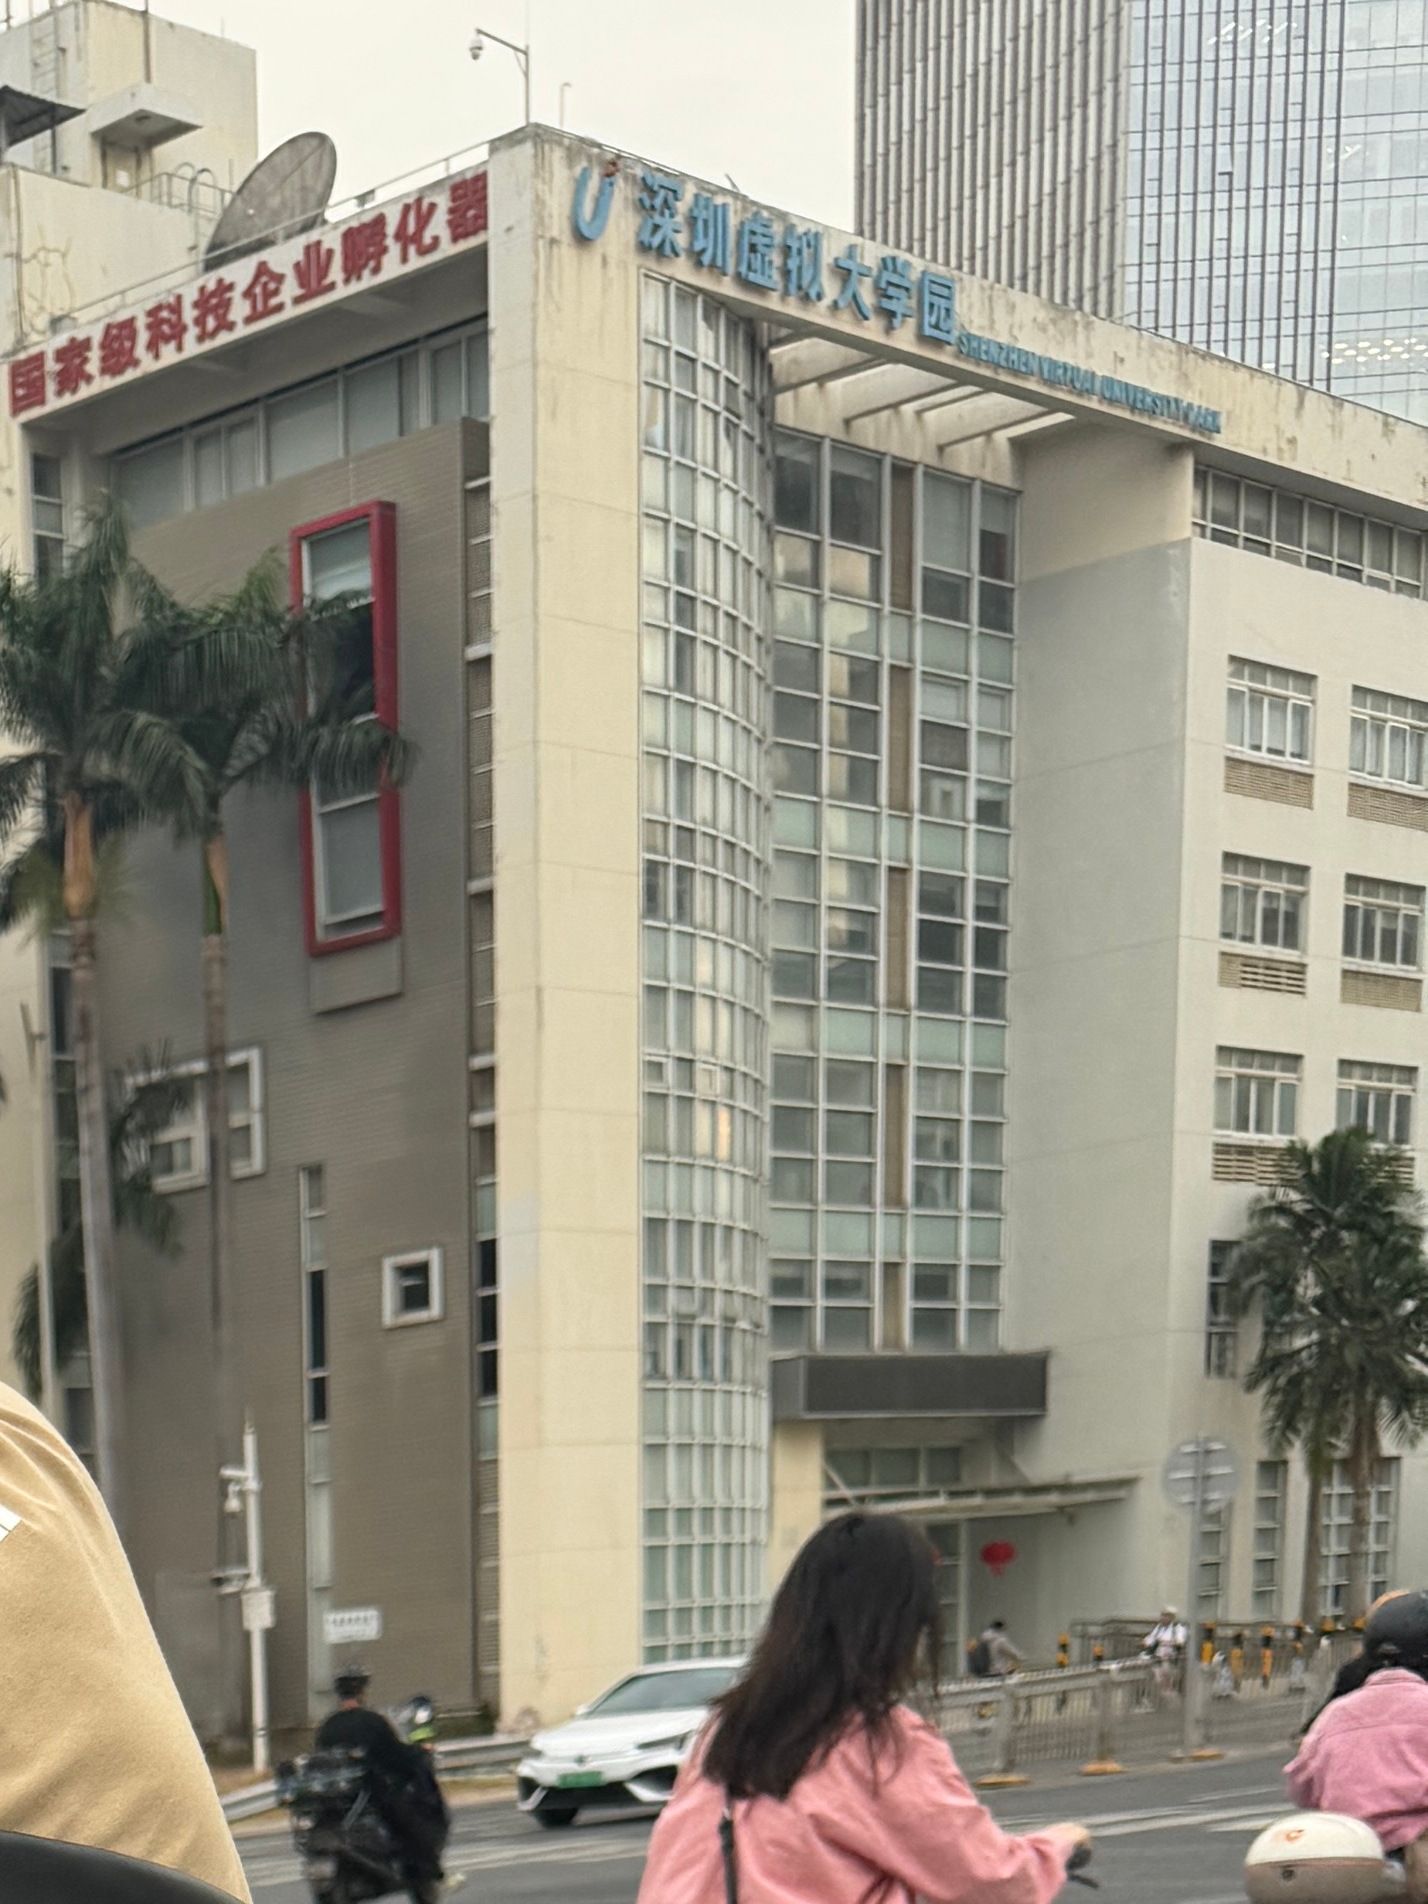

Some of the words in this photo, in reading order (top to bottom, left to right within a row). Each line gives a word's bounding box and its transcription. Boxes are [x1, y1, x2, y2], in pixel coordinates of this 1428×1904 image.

[8, 170, 488, 418] 国家级科技企业孵化器
[638, 172, 956, 346] 深圳虚拟大学园
